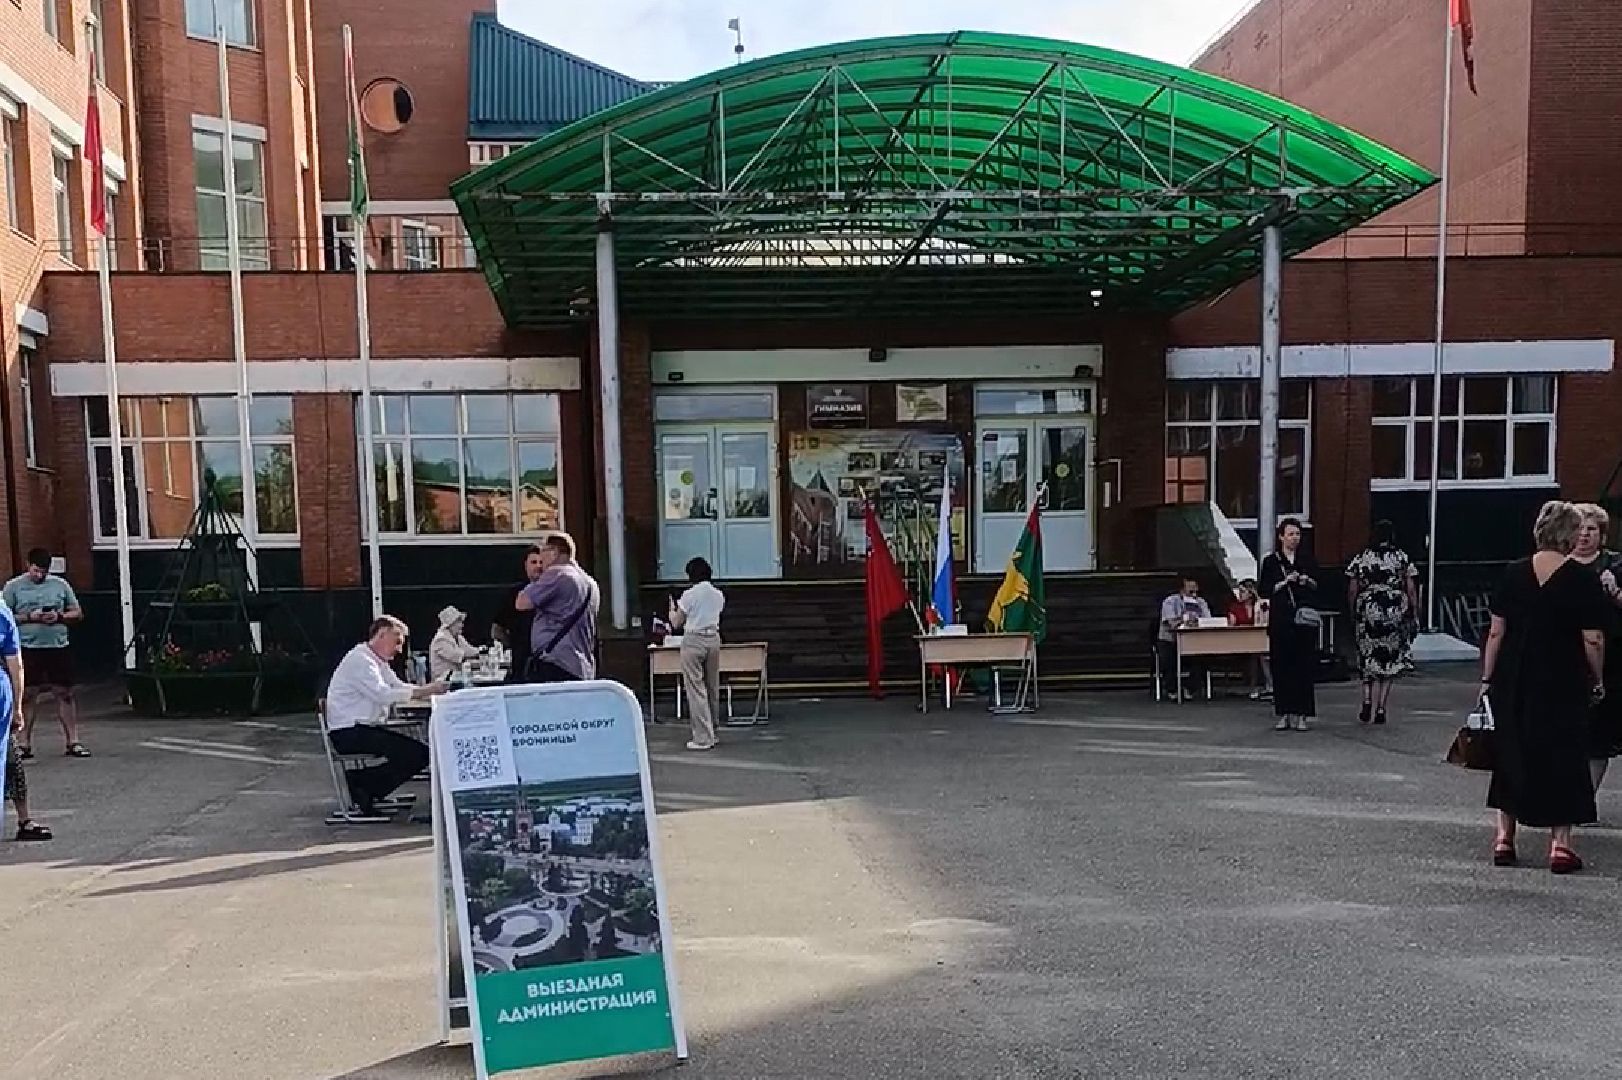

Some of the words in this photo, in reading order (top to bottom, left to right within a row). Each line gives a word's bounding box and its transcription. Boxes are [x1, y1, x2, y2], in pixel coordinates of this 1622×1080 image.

[511, 719, 579, 734] ГОРОДСКОЙ
[581, 718, 615, 730] ОКРУГ
[512, 734, 577, 747] БРОННИЦЫ
[527, 973, 624, 998] ВЫЕЗДНАЯ
[497, 989, 657, 1024] АДМИНИСТРАЦИЯ
